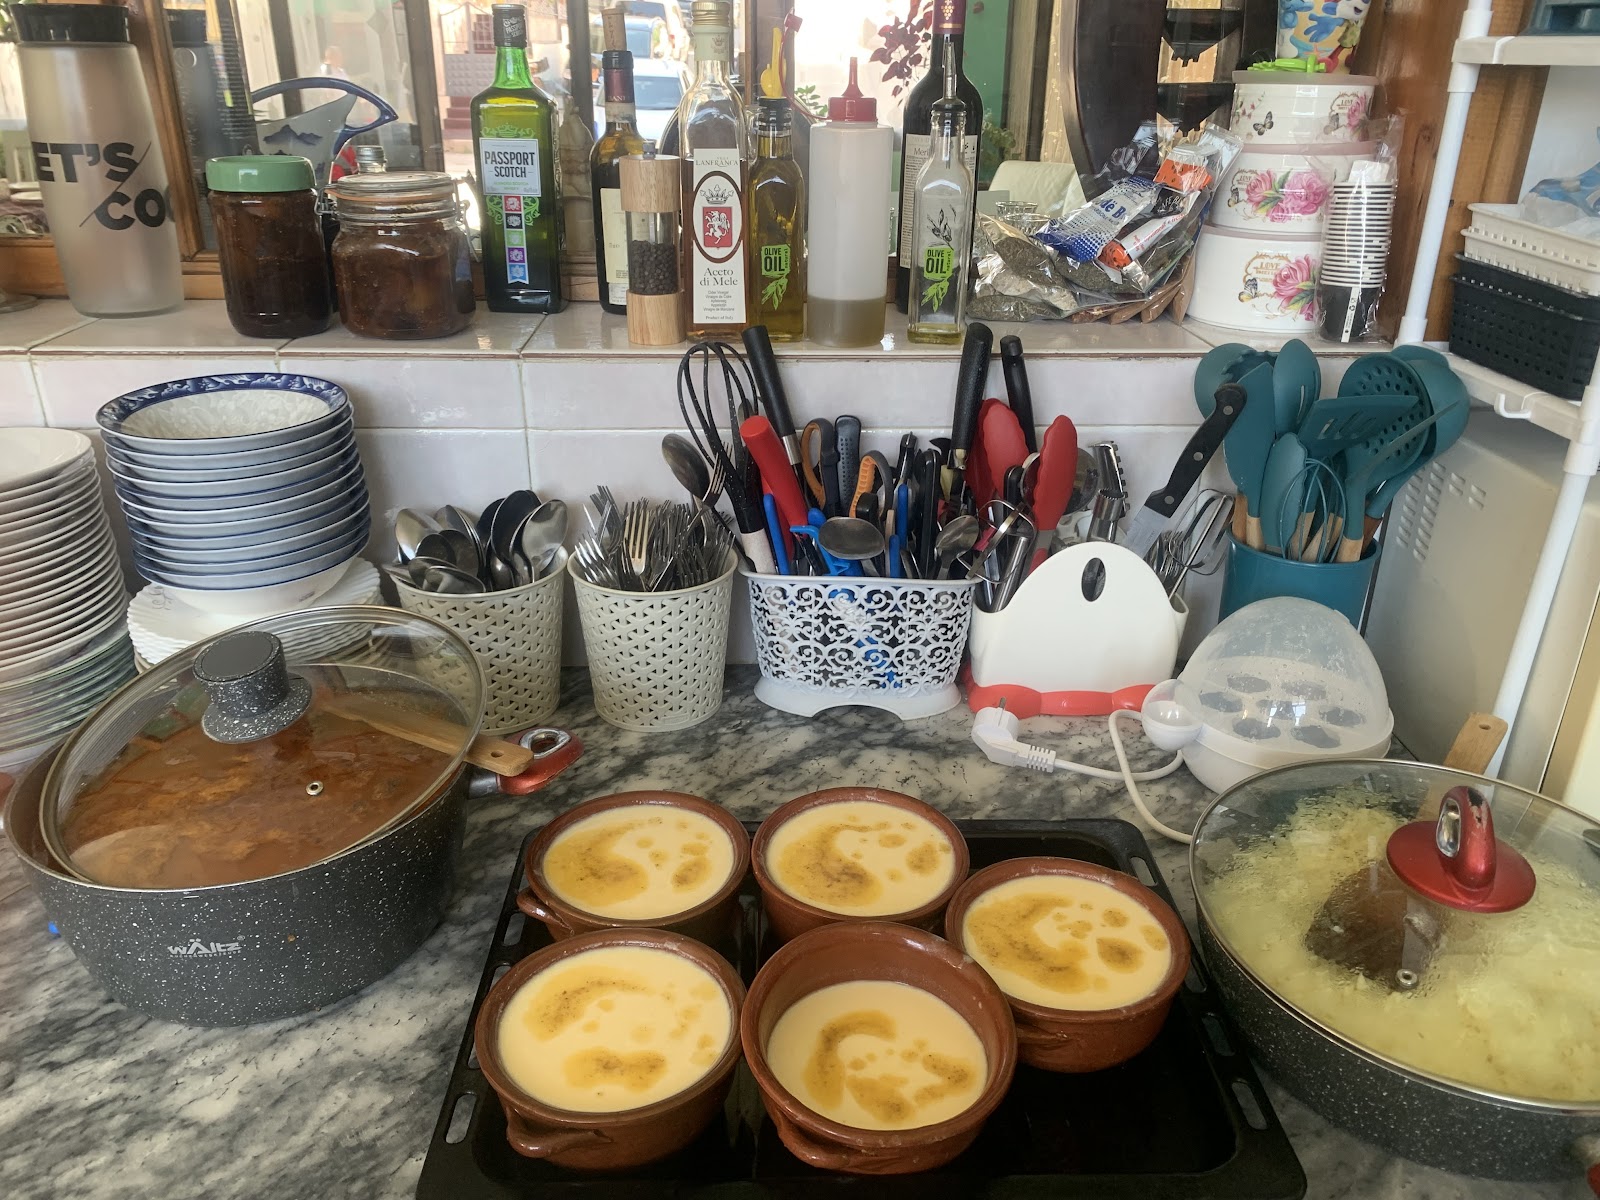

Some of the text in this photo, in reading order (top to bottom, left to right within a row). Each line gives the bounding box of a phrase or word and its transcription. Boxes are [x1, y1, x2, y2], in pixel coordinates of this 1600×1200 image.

[484, 151, 535, 166] PASSPORT
[494, 166, 526, 178] SCOTCH
[95, 188, 174, 230] CO
[764, 248, 782, 256] OLIVE
[927, 249, 945, 258] OLIVE
[764, 256, 785, 272] OIL
[926, 257, 947, 273] OIL
[704, 267, 734, 276] Aceto
[699, 277, 738, 286] di Mele
